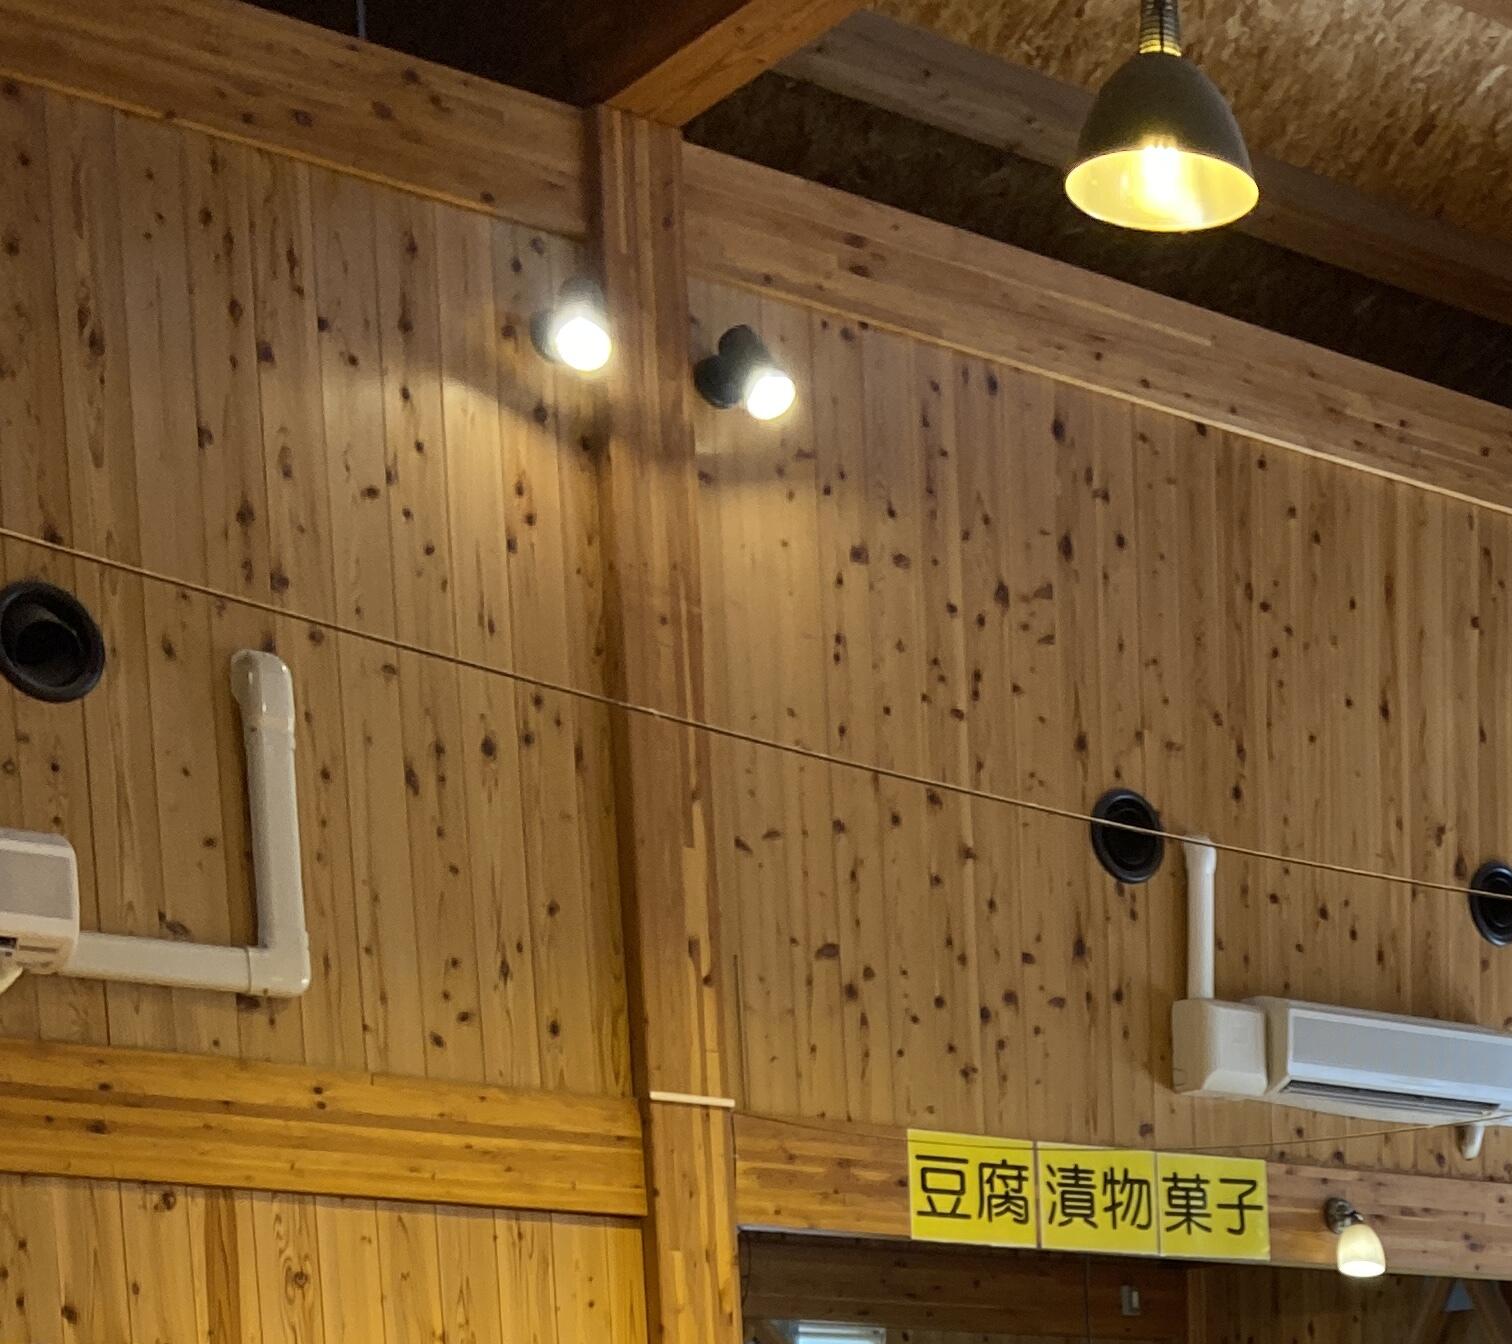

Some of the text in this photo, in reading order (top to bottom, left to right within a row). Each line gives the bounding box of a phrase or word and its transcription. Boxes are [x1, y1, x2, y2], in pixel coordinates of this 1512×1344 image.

[915, 1154, 1264, 1235] 豆腐漬物菓子
